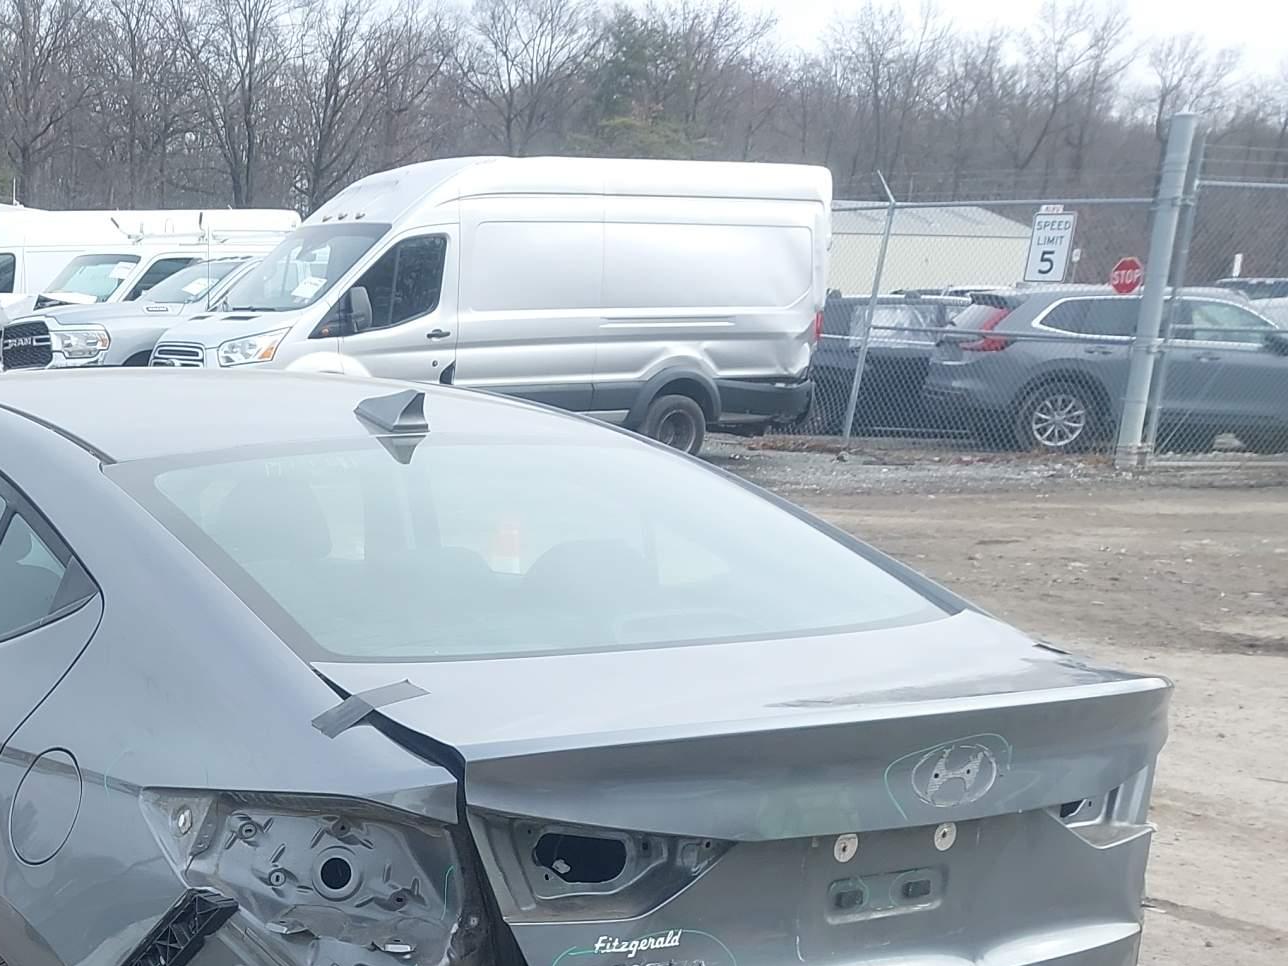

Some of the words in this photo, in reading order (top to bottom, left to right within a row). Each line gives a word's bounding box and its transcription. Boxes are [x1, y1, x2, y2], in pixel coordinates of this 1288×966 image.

[1036, 220, 1071, 231] SPEED
[1036, 235, 1064, 246] LIMIT
[1037, 250, 1055, 274] 5
[1112, 269, 1142, 285] STOP
[8, 336, 32, 347] RAM
[594, 929, 682, 958] Fitzgerald
